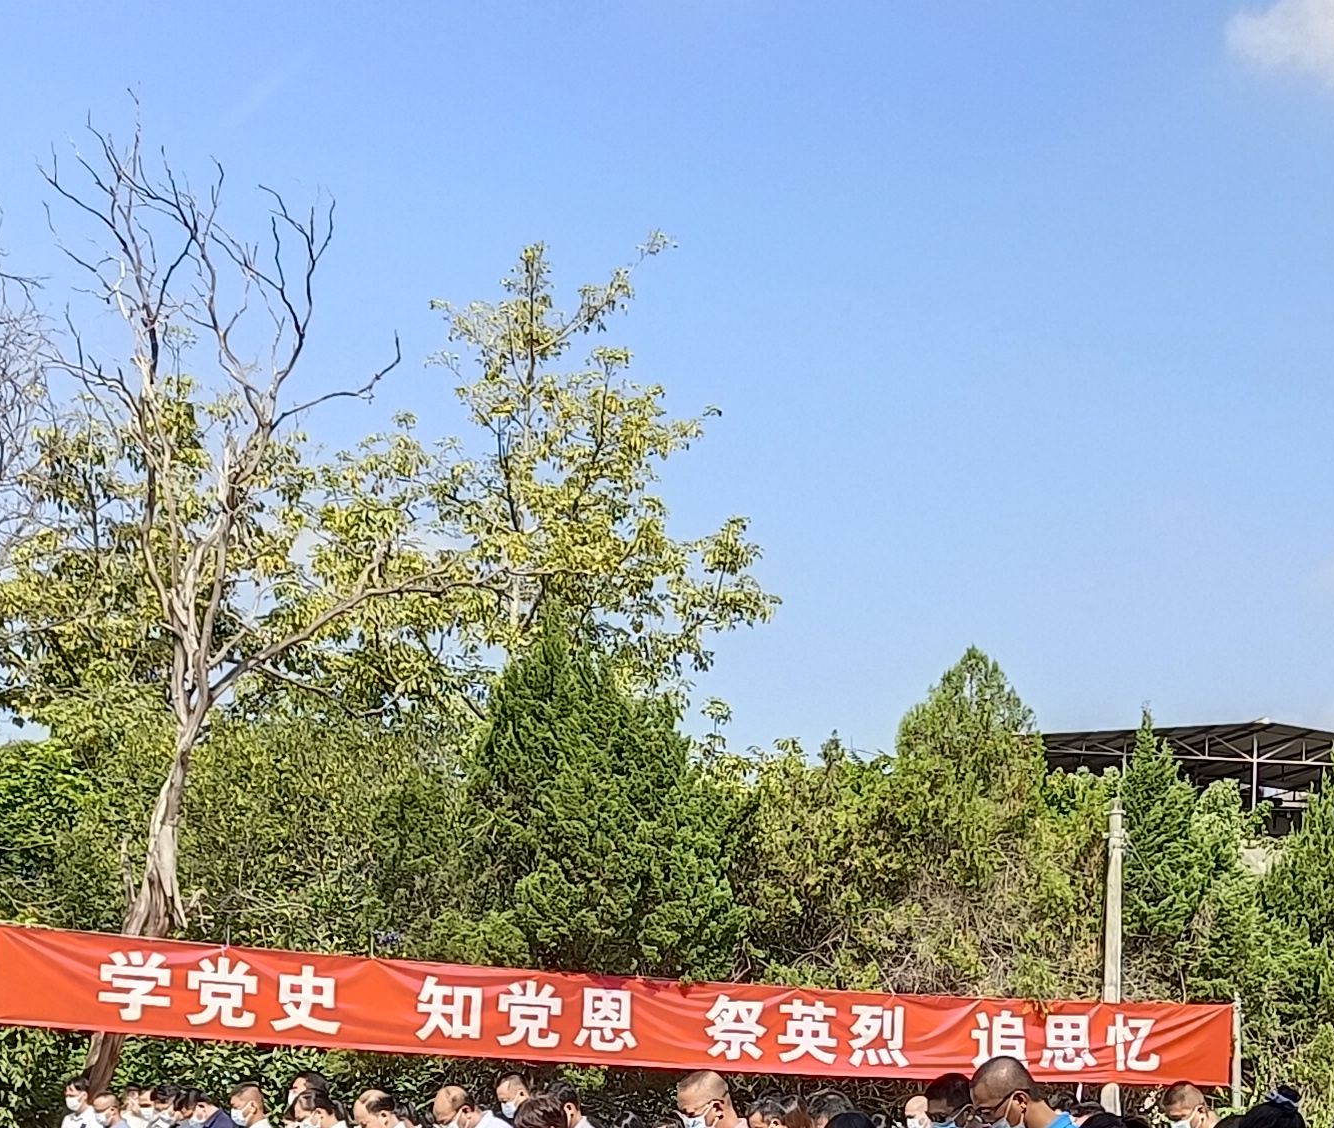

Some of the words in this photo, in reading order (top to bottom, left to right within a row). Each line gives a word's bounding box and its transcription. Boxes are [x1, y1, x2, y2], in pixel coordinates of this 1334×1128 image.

[98, 950, 342, 1035] 学党史
[415, 976, 638, 1053] 知党恩
[704, 993, 910, 1069] 祭英烈
[971, 1010, 1161, 1073] 追思忆
